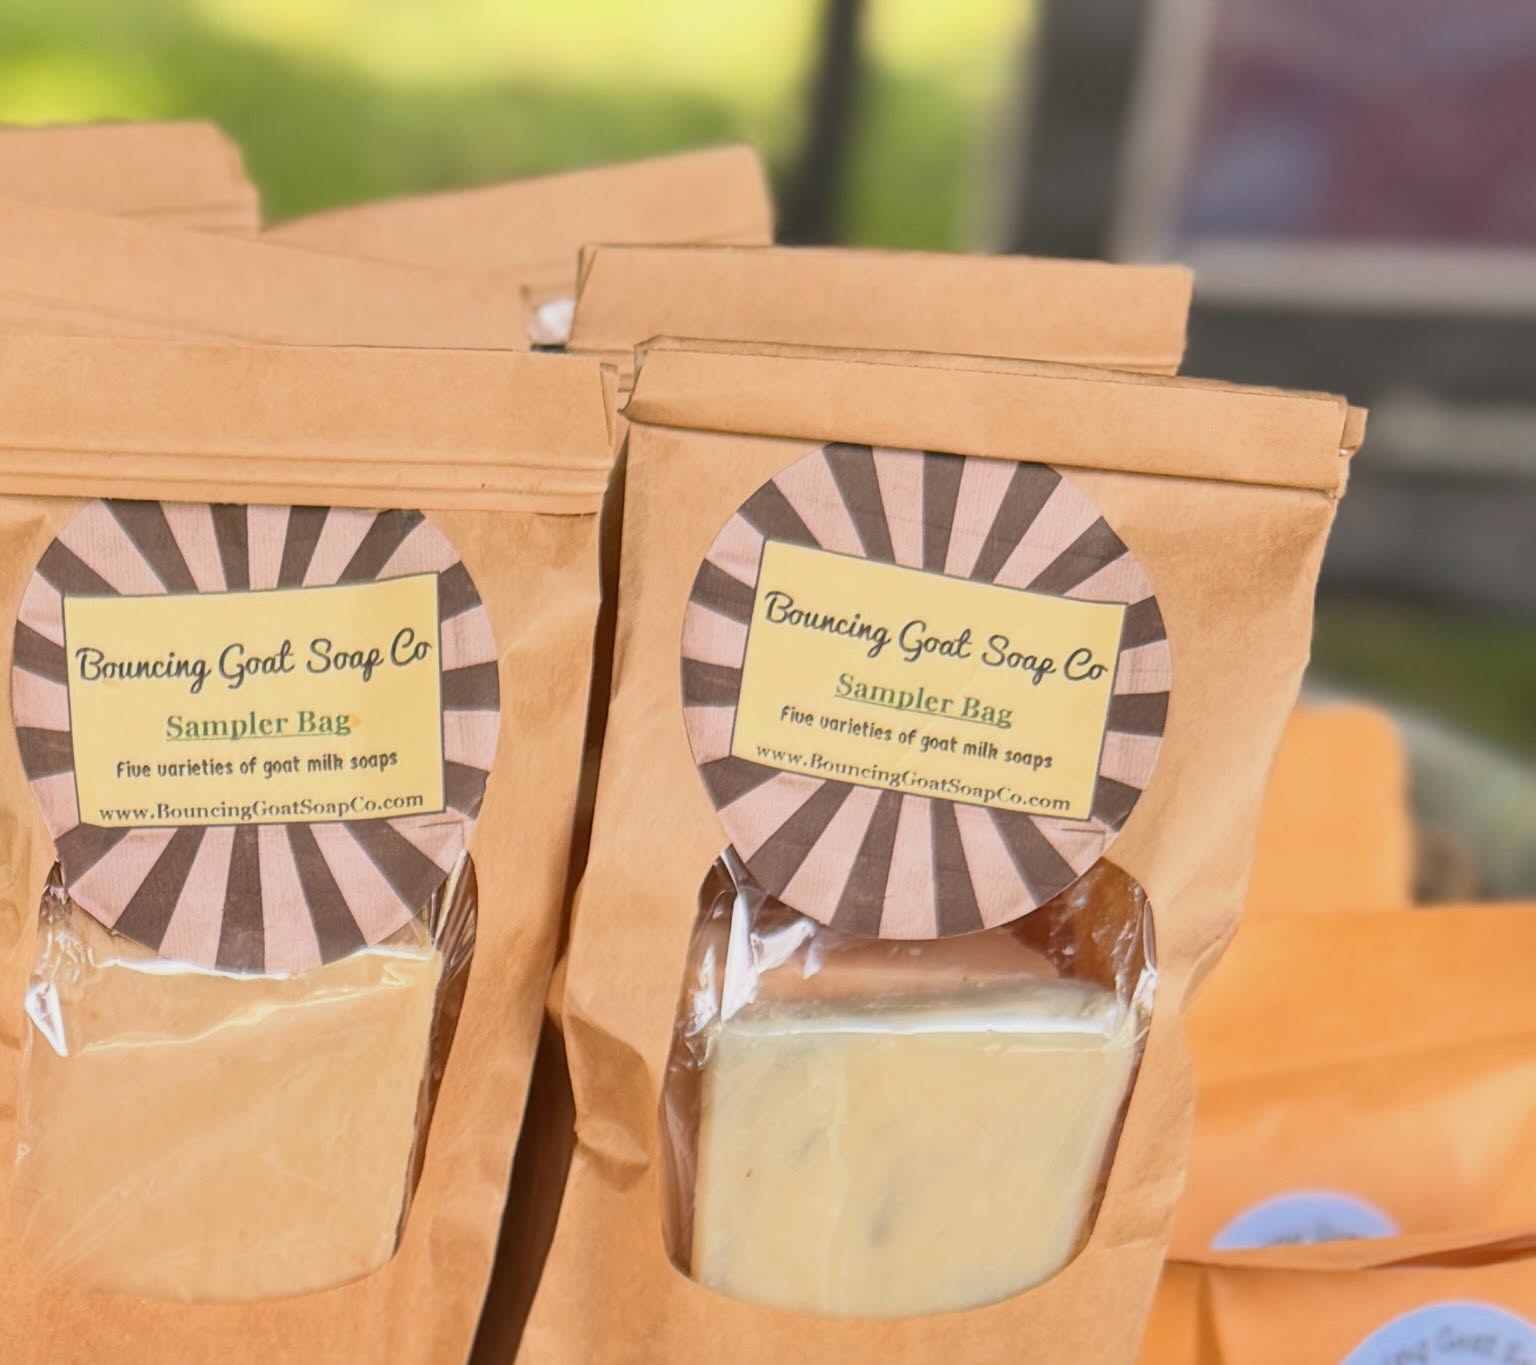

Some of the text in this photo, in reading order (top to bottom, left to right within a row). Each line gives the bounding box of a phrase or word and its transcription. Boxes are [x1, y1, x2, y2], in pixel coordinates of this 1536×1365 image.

[74, 627, 432, 693] Bouncing Goat Soap Co
[764, 590, 1108, 685] Bouncing Goat Soap Co
[165, 710, 352, 741] Sampler Bag
[834, 673, 1015, 729] Sampler Bag
[116, 751, 398, 778] Five varieties of goat milk soaps
[780, 706, 1053, 772] Five varieties of goat milk soaps
[99, 793, 424, 821] www.BouncingGoatSoapCo.com
[755, 745, 1071, 812] www.BouncingGoatSoapCo.com
